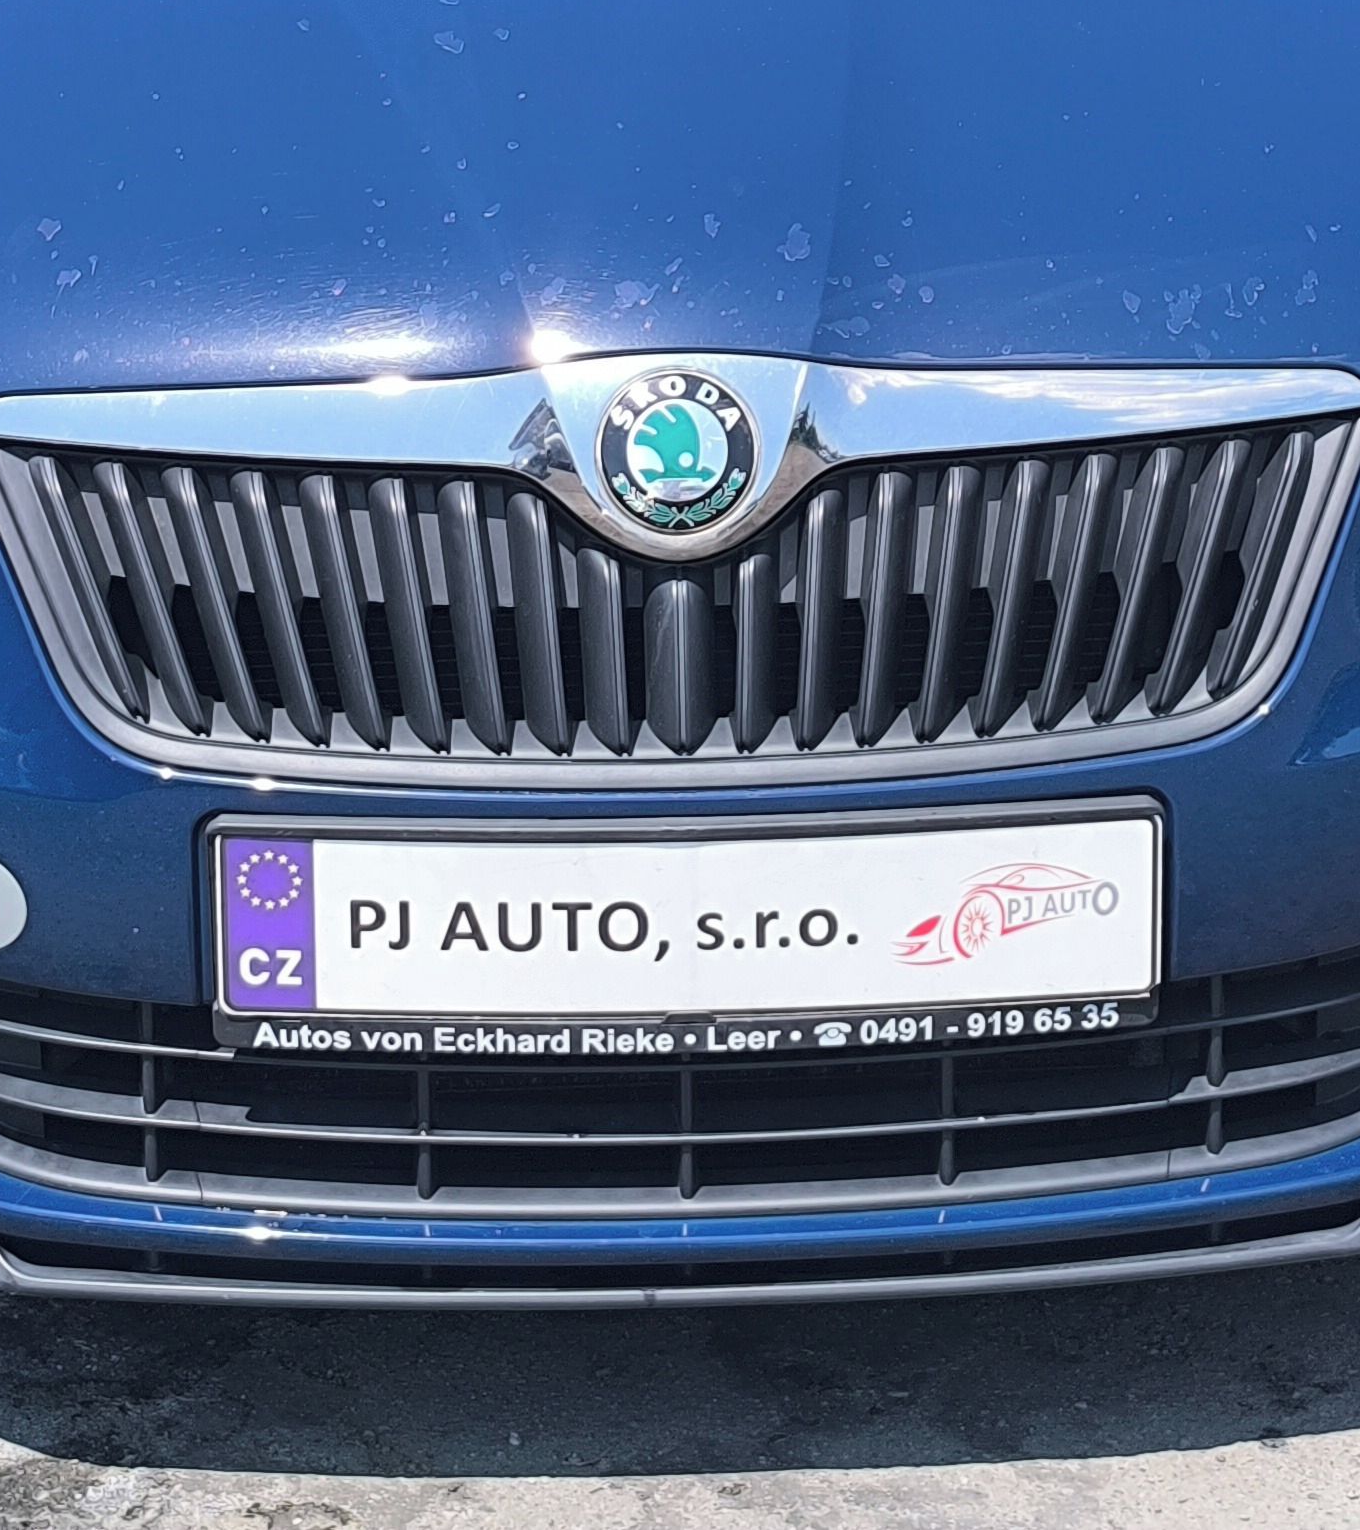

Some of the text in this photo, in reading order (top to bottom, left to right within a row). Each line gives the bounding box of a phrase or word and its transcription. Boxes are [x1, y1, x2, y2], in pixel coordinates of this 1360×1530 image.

[1007, 881, 1120, 925] PJ AUTO
[350, 900, 859, 962] PJ AUTO, s.r.o.
[240, 947, 303, 987] CZ
[253, 1021, 351, 1052] Autos
[361, 1029, 423, 1052] von
[434, 1027, 570, 1054] Eckhard
[582, 1028, 675, 1054] Rieke
[707, 1025, 782, 1052] Leer
[860, 1015, 935, 1045] 0491
[967, 1009, 1024, 1037] 919
[1034, 1006, 1072, 1032] 65
[1081, 1002, 1120, 1028] 35
